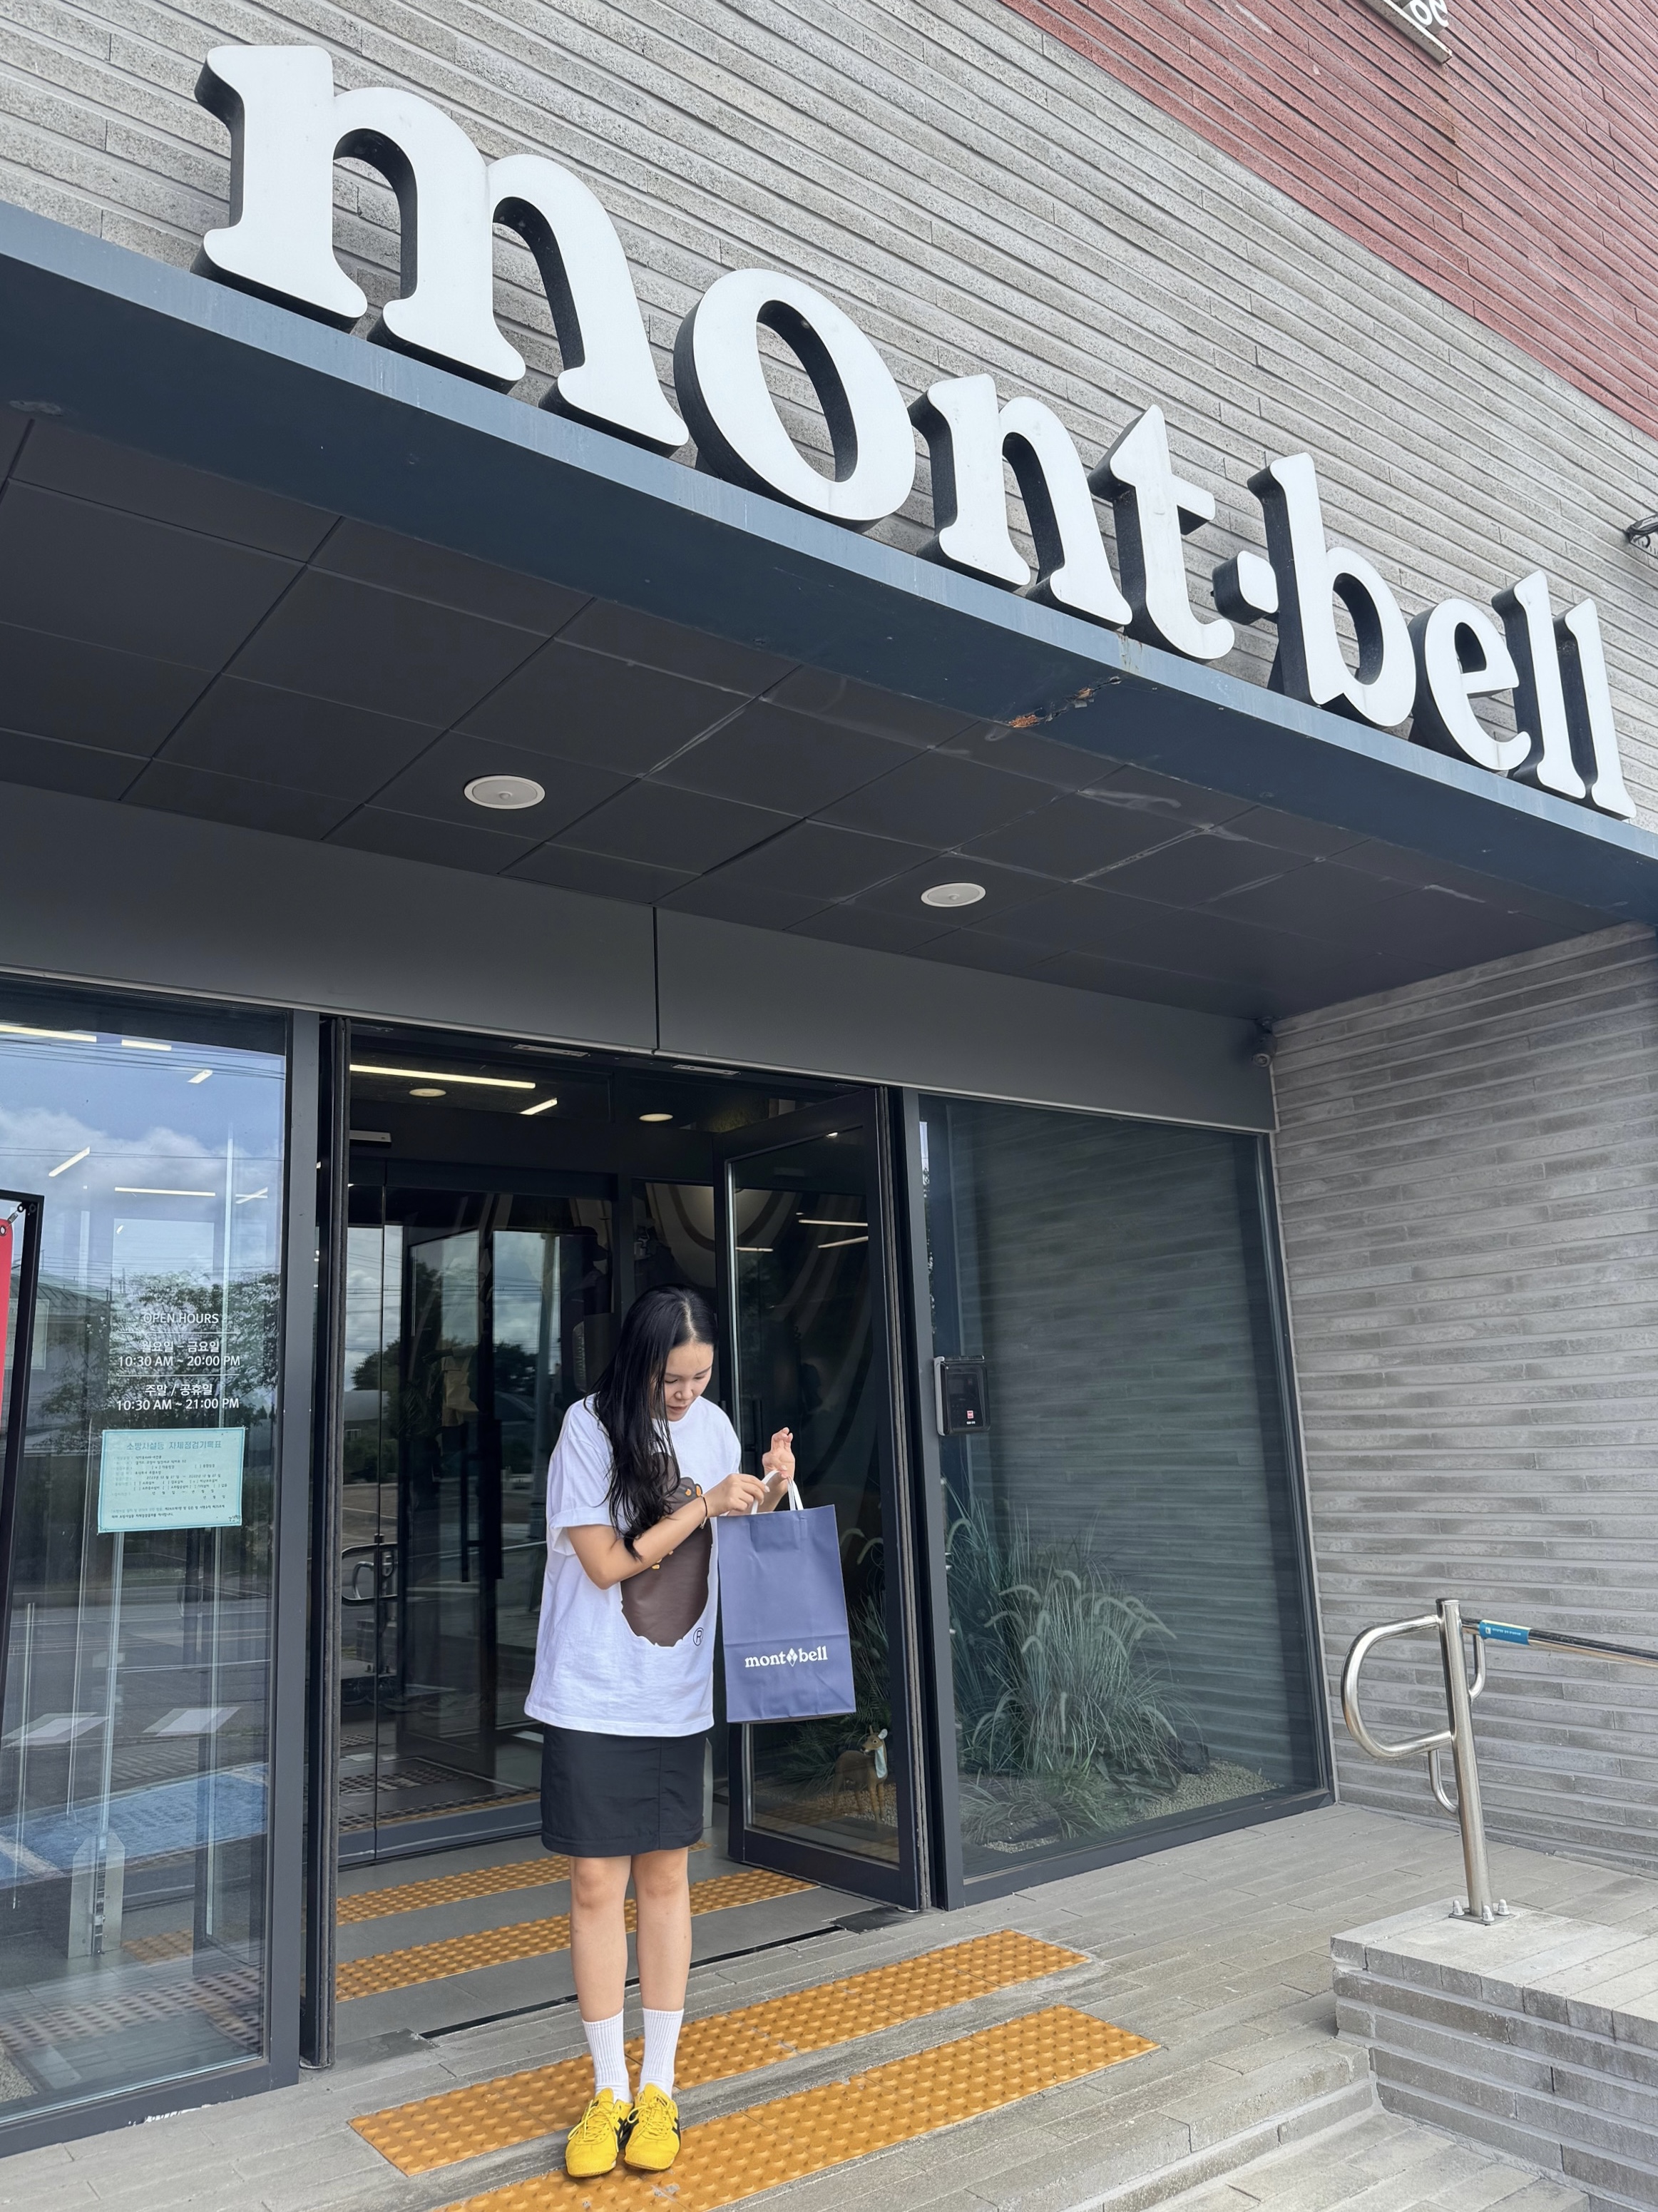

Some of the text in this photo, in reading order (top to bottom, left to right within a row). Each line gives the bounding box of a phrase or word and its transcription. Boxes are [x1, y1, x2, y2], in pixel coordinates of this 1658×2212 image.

[143, 1313, 220, 1324] OPEN HOURS
[142, 1341, 174, 1353] 월요일
[187, 1341, 220, 1353] 금요일
[118, 1357, 152, 1367] 10:30
[155, 1356, 173, 1366] AM
[187, 1356, 220, 1366] 20:00
[223, 1355, 240, 1366] PM
[145, 1385, 168, 1396] 주말
[180, 1384, 213, 1396] 공휴일
[116, 1400, 150, 1411] 10:30
[153, 1400, 172, 1410] AM
[185, 1399, 219, 1410] 21:00
[222, 1398, 240, 1409] PM
